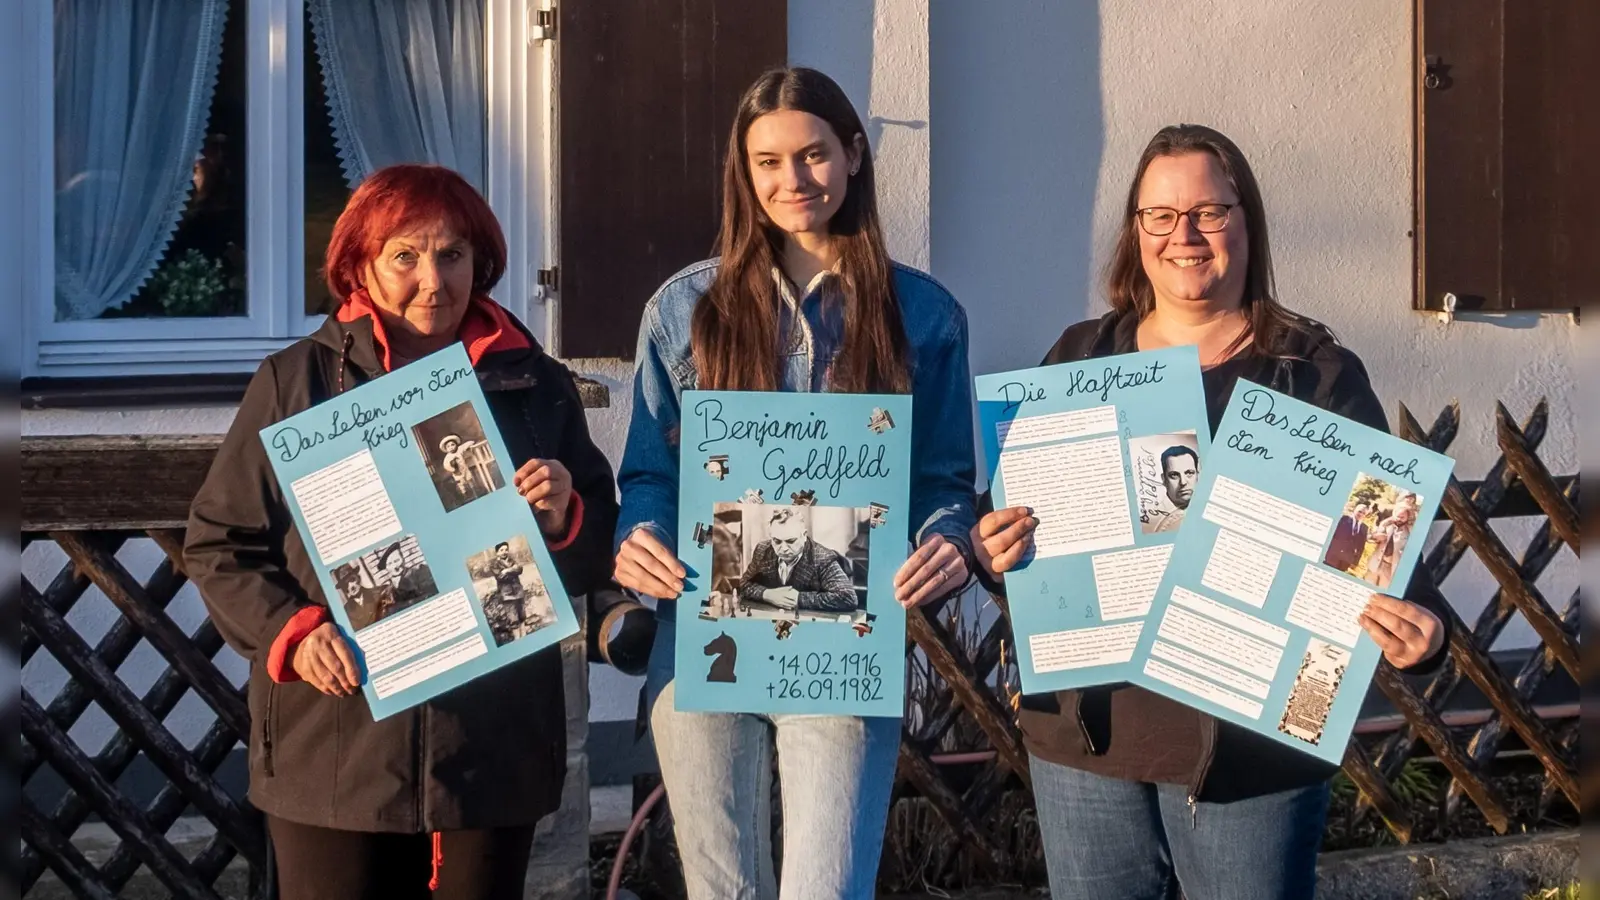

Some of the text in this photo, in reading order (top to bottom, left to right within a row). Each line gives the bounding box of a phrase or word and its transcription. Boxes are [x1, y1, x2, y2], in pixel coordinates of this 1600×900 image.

[997, 360, 1166, 414] Die Haftzeit
[272, 426, 324, 462] Das
[328, 402, 387, 439] Leben
[390, 387, 423, 412] vor
[361, 421, 408, 450] Krieg
[694, 399, 828, 451] Benjamin
[1241, 389, 1422, 485] Das Leben nach
[762, 444, 890, 500] Goldfeld
[1294, 451, 1337, 496] Krieg
